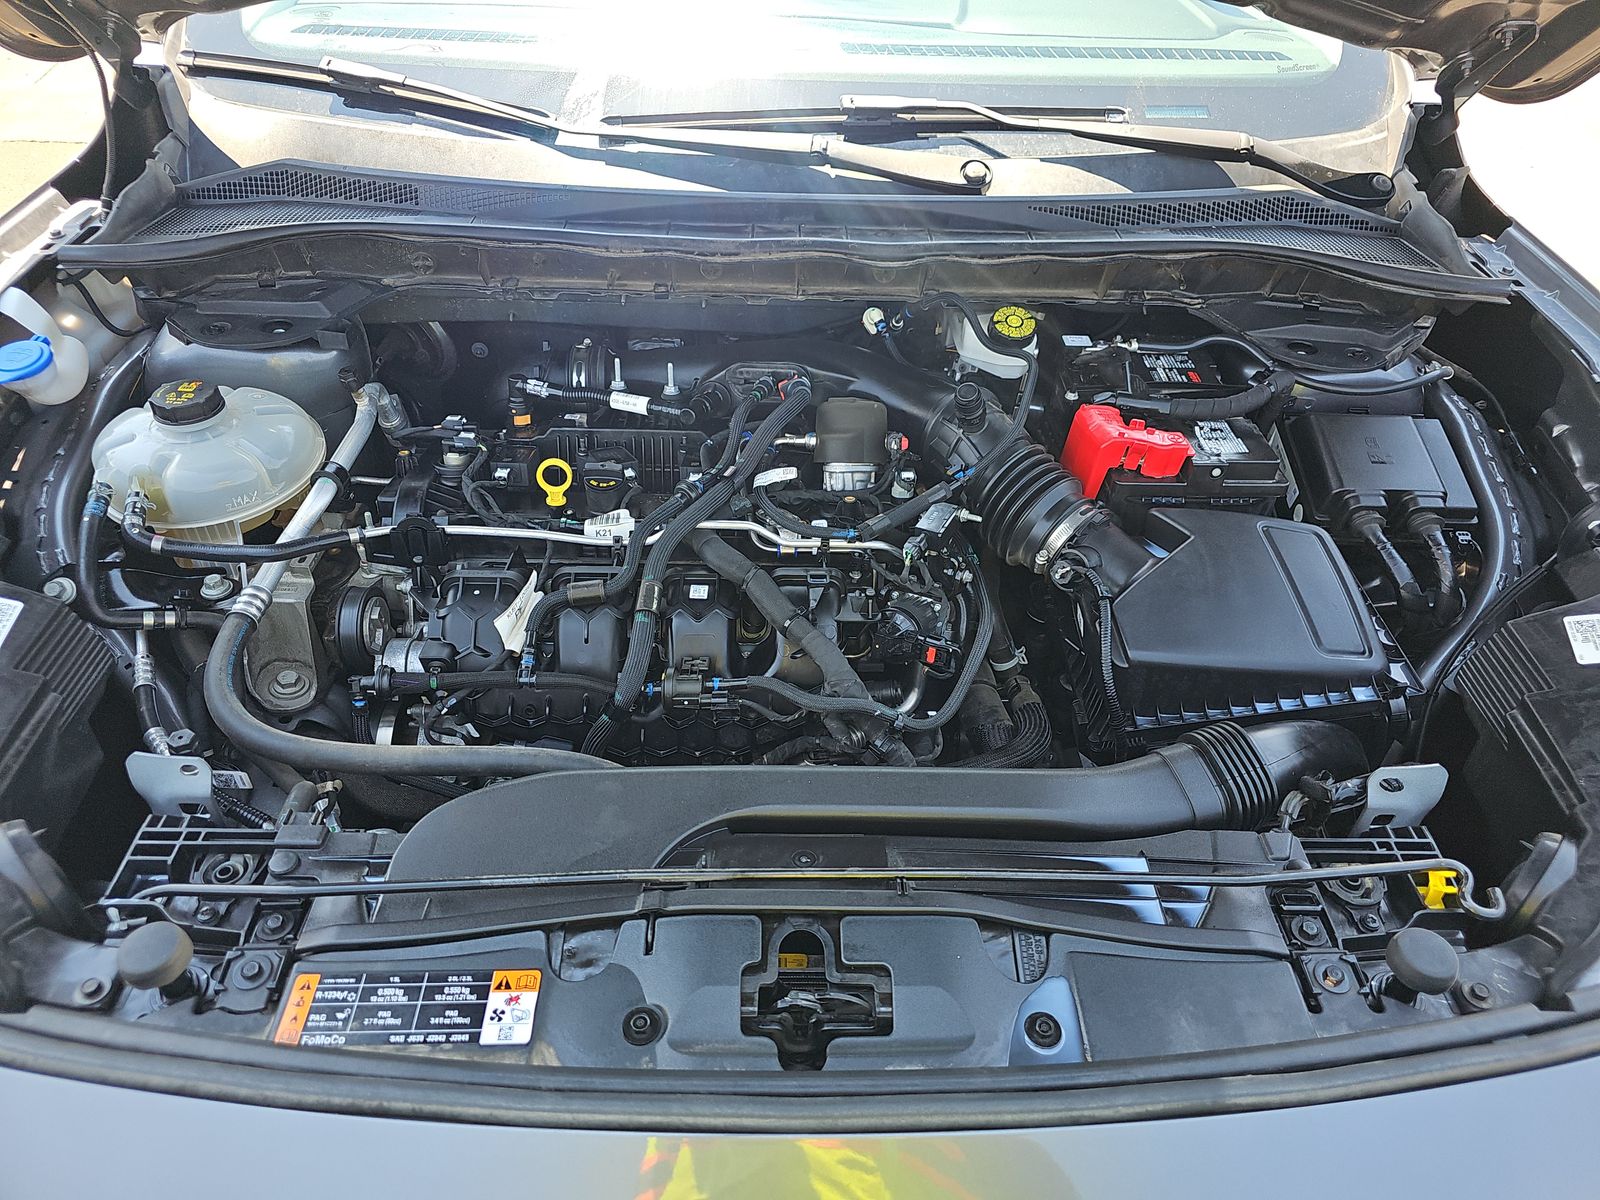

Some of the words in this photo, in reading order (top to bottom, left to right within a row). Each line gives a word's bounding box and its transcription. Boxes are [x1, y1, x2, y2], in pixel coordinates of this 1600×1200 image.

[232, 490, 261, 507] MAX
[595, 529, 612, 537] K21
[309, 1013, 327, 1021] PAG
[301, 1034, 346, 1045] FoMoCo
